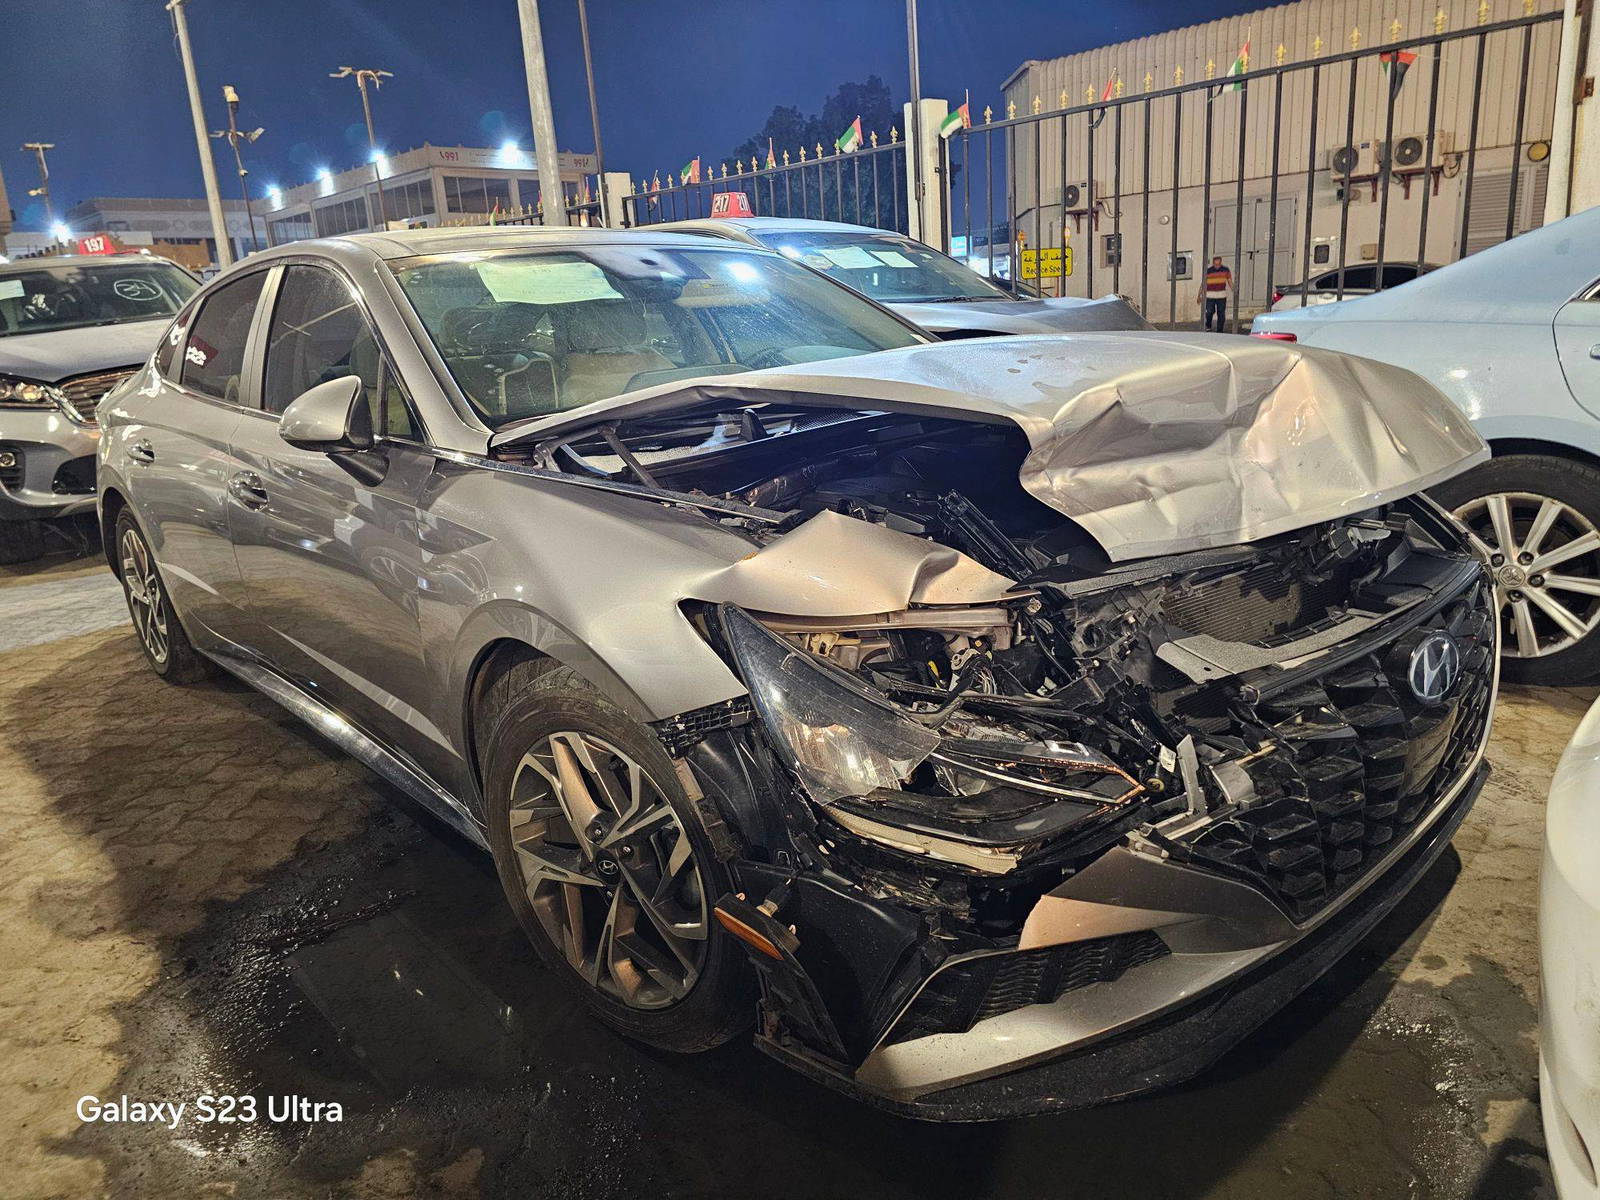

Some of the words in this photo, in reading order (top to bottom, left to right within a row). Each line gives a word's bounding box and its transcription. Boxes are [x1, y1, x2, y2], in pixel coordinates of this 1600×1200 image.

[713, 194, 730, 212] 217
[84, 236, 105, 252] 197
[1026, 266, 1048, 274] Rece
